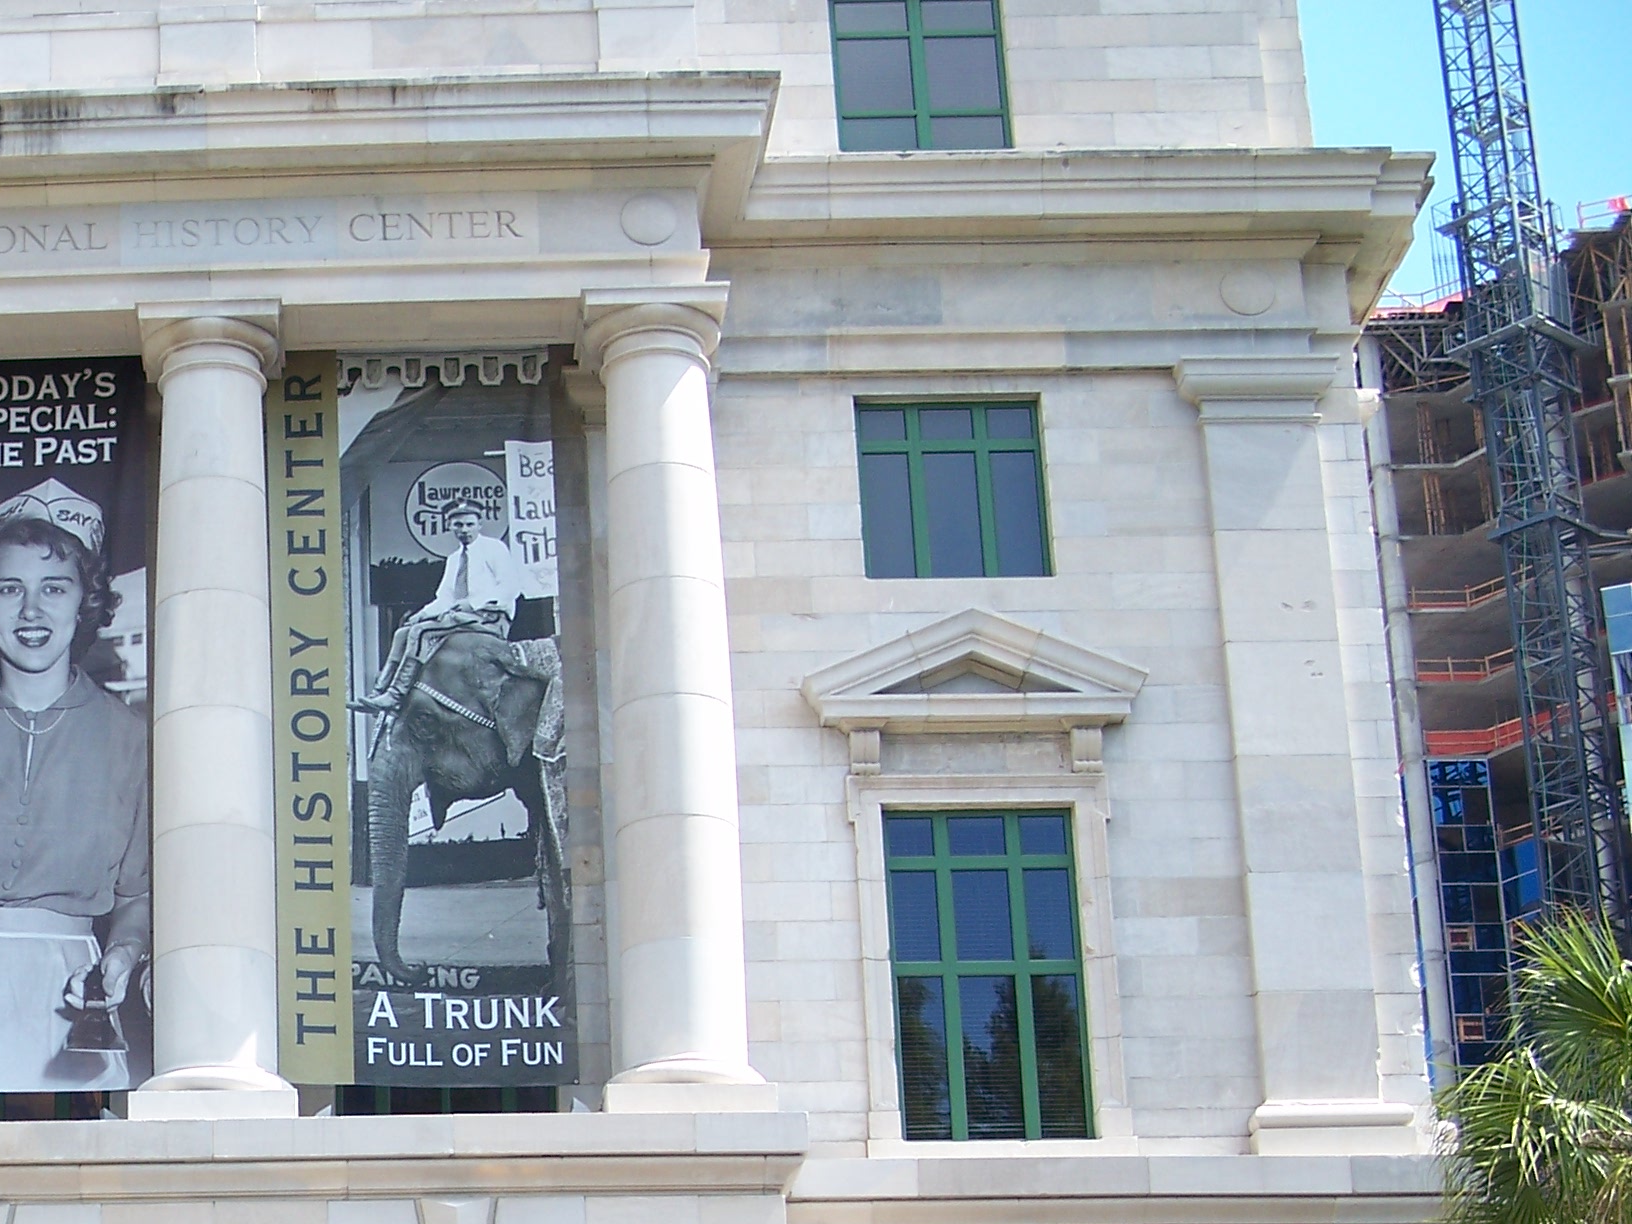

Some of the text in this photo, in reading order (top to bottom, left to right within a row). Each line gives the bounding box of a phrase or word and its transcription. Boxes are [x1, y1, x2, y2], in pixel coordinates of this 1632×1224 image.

[134, 214, 322, 250] HISTORY
[348, 209, 523, 242] CENTER
[34, 436, 118, 466] PAST
[417, 481, 505, 509] Lawrence
[283, 373, 338, 1046] THE HISTORY CENTER
[367, 990, 562, 1030] A TRUNK
[367, 1037, 564, 1067] FULL OF FUN
